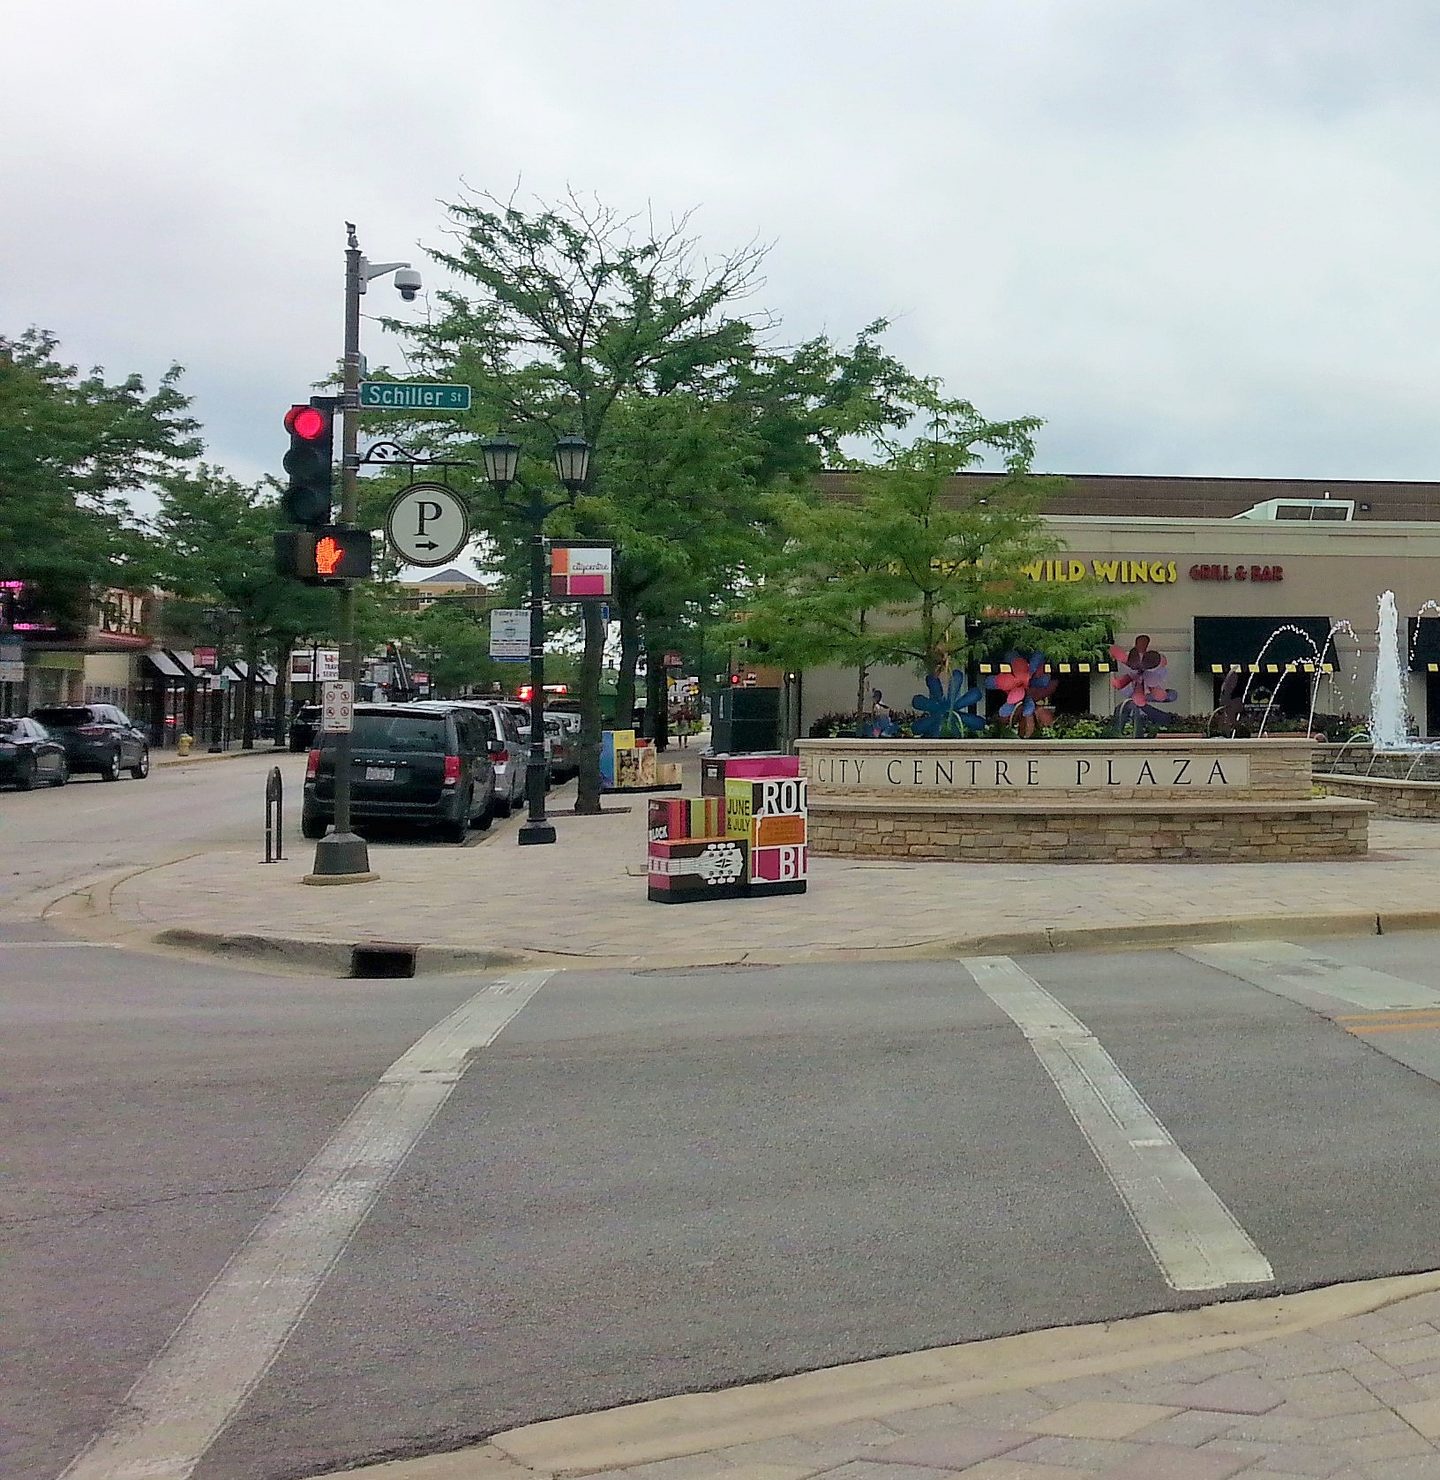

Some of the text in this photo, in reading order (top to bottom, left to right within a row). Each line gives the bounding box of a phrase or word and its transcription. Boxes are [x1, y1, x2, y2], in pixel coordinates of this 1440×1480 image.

[369, 385, 462, 405] Schiller St
[414, 501, 443, 536] P
[1020, 559, 1086, 582] WILD
[1092, 560, 1177, 583] WINGS
[1189, 564, 1232, 581] GRILL
[1234, 565, 1247, 581] &
[1250, 565, 1284, 582] BAR
[818, 758, 1228, 786] CITY CENTRE PLAZA
[727, 798, 750, 816] JUNE
[727, 817, 733, 830] &
[733, 818, 751, 832] JULY
